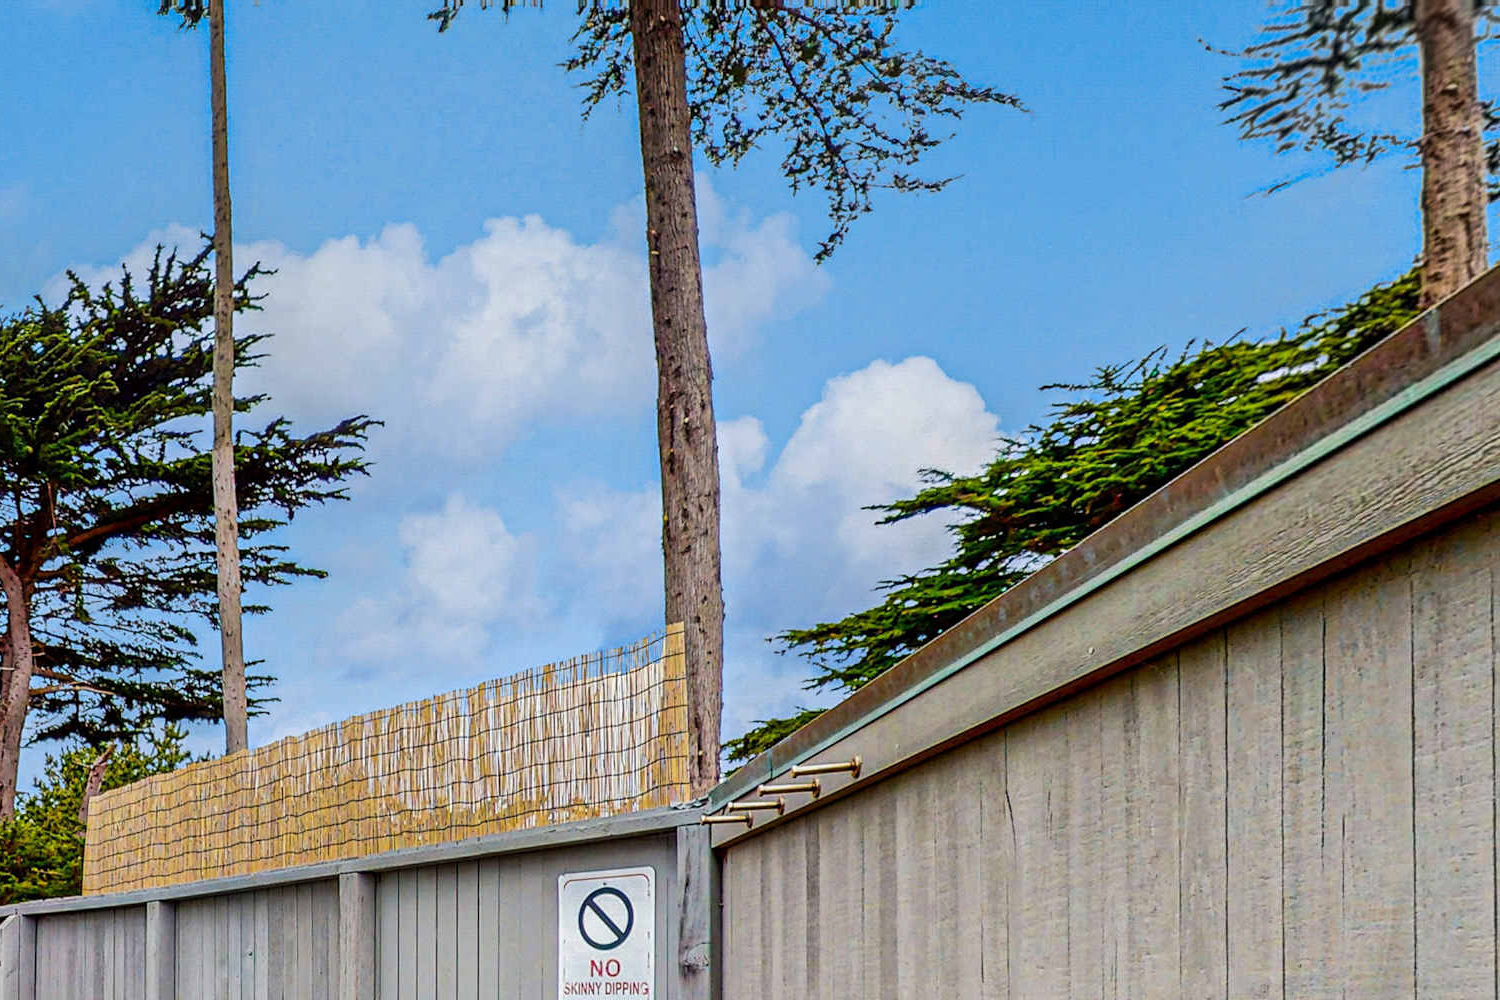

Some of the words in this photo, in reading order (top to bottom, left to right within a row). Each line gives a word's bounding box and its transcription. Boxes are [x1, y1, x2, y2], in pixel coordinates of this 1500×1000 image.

[590, 959, 621, 977] NO
[564, 982, 602, 996] SKINNY
[605, 981, 649, 995] DIPPING
